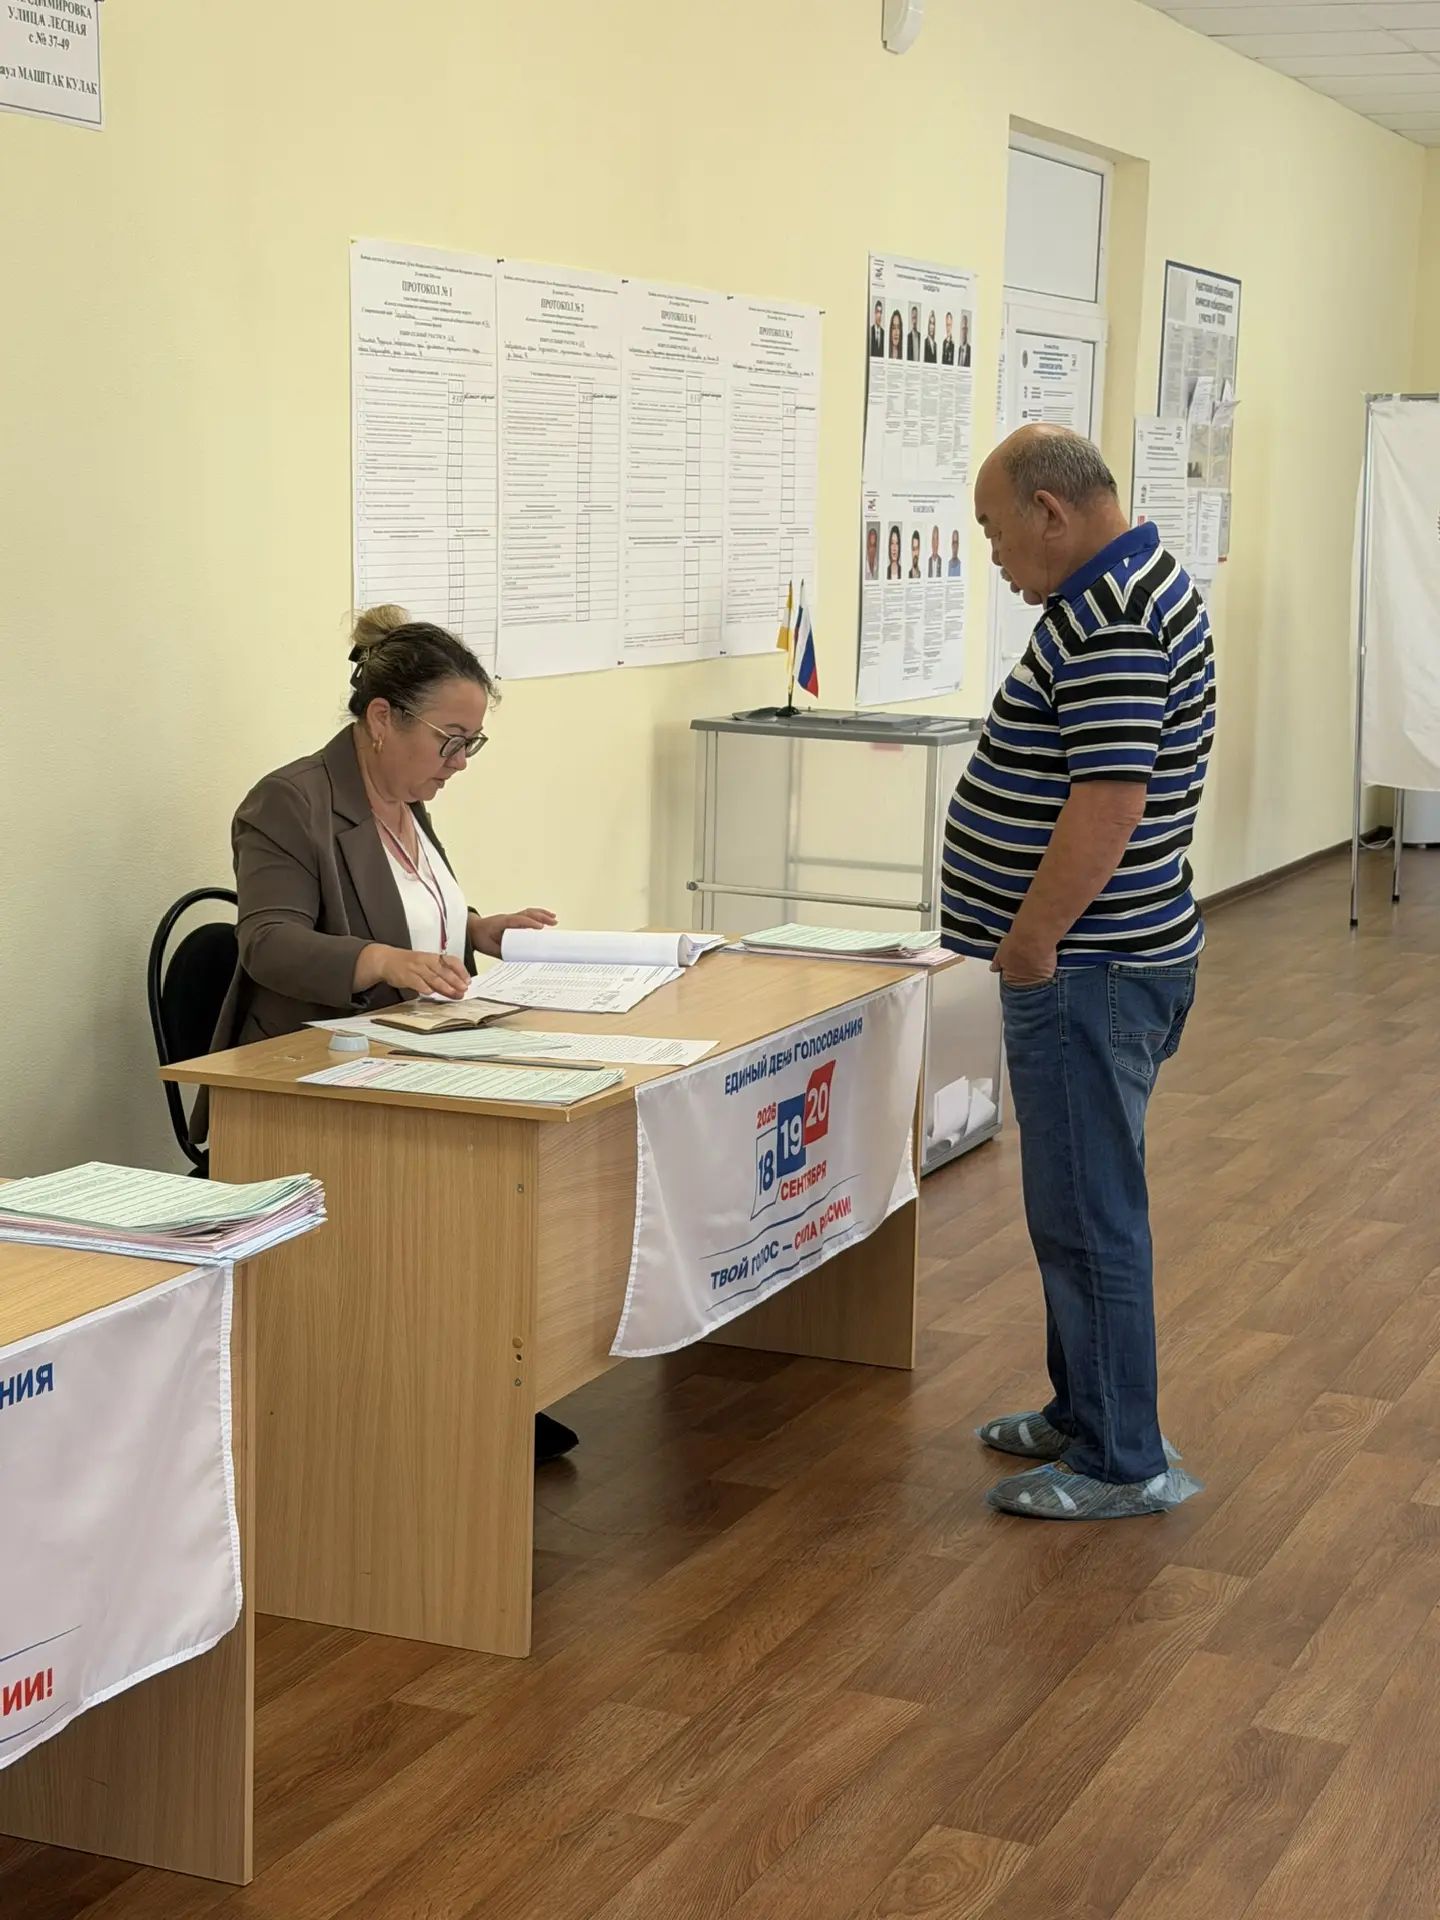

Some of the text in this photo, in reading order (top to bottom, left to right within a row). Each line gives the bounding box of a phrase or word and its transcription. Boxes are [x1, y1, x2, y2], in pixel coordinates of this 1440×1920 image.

[8, 5, 87, 36] УЛИЦА ЛЕСНАЯ
[17, 0, 92, 19] ИМИРОВКА
[48, 34, 70, 51] 37-49
[18, 65, 64, 88] МАШТАК
[66, 76, 97, 95] КУЛАК
[402, 280, 440, 297] ПРОТОКОЛ
[724, 1054, 767, 1095] ЕДИНЫЙ
[794, 1017, 863, 1062] ГОЛОСОВАНИЯ
[759, 1082, 828, 1196] 18 19 20
[781, 1160, 827, 1201] СЕНТЯБРЯ
[711, 1256, 749, 1290] ТВОЙ
[820, 1196, 852, 1235] РСИИ!
